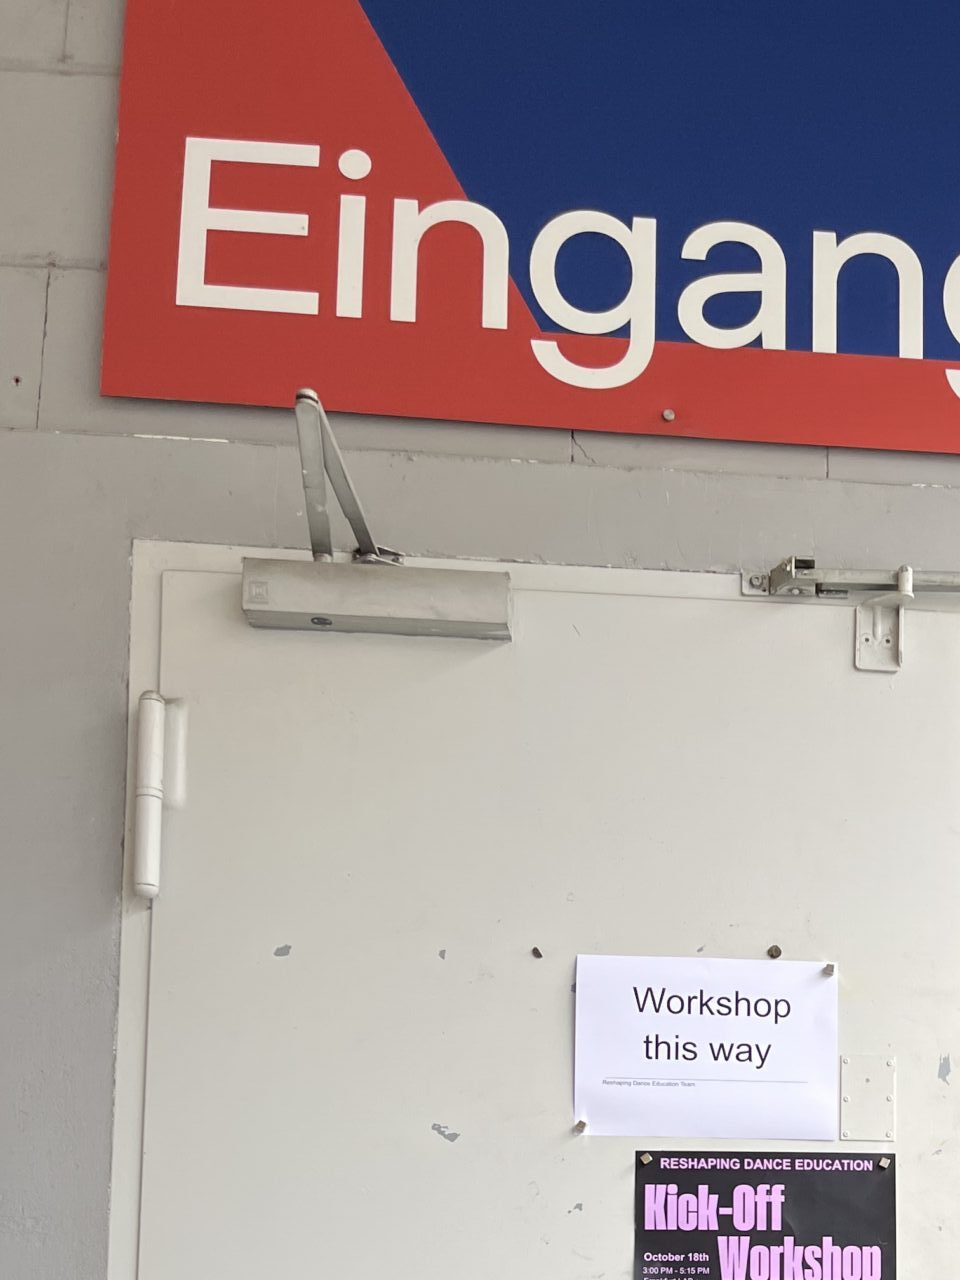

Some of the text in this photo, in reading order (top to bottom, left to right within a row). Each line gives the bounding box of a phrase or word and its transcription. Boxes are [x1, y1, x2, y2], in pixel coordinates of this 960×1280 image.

[633, 986, 791, 1024] Workshop
[643, 1034, 772, 1069] this way
[660, 1157, 873, 1171] RESHAPING DANCE EDUCATION
[644, 1183, 785, 1231] Kick-Off
[643, 1252, 710, 1261] October 18th
[642, 1266, 659, 1275] 3:00
[660, 1266, 673, 1275] PM
[680, 1267, 696, 1275] 5:15
[697, 1267, 710, 1275] PM
